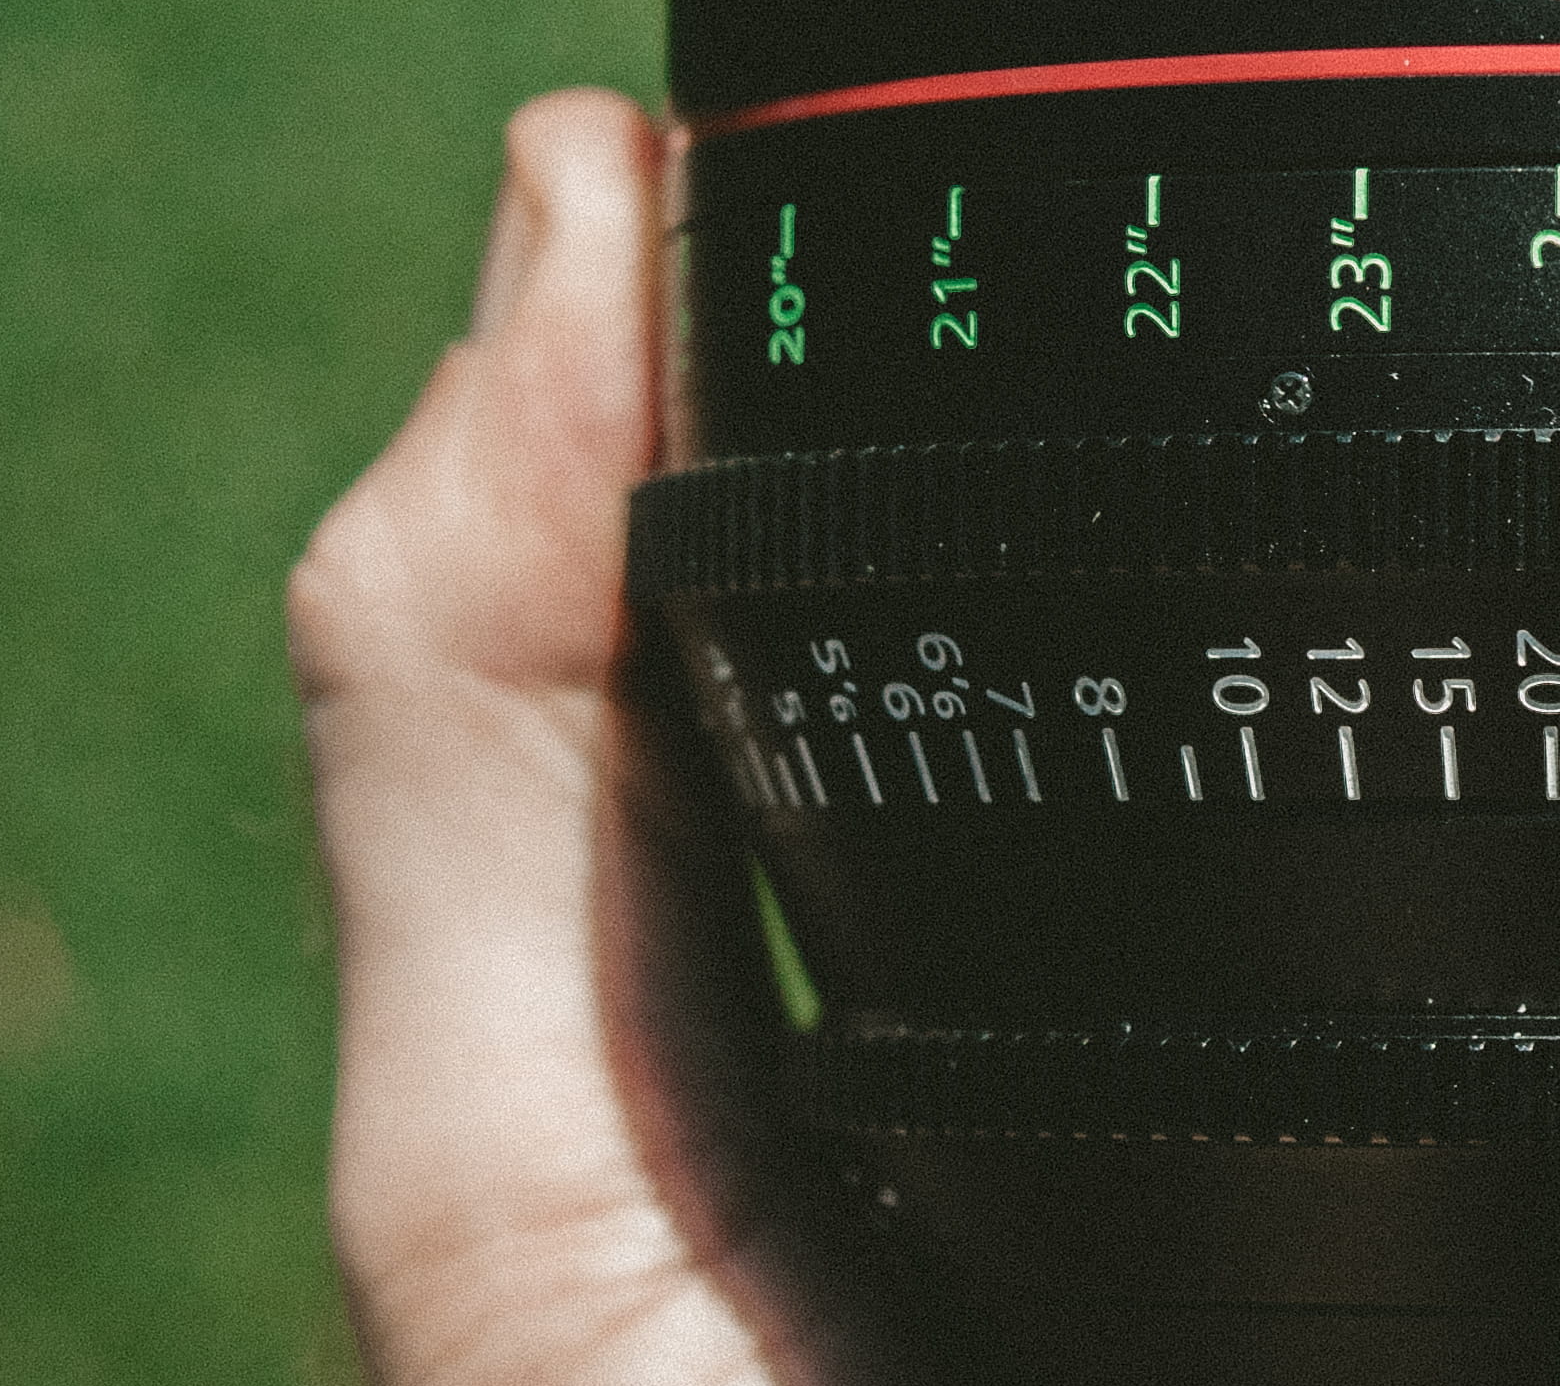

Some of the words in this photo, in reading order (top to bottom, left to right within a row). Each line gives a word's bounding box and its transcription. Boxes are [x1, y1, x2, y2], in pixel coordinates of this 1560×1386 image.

[985, 680, 1036, 719] 7
[1073, 675, 1127, 716] 8
[1206, 636, 1271, 716] 10
[1306, 636, 1371, 715] 12
[1410, 635, 1478, 715] 15
